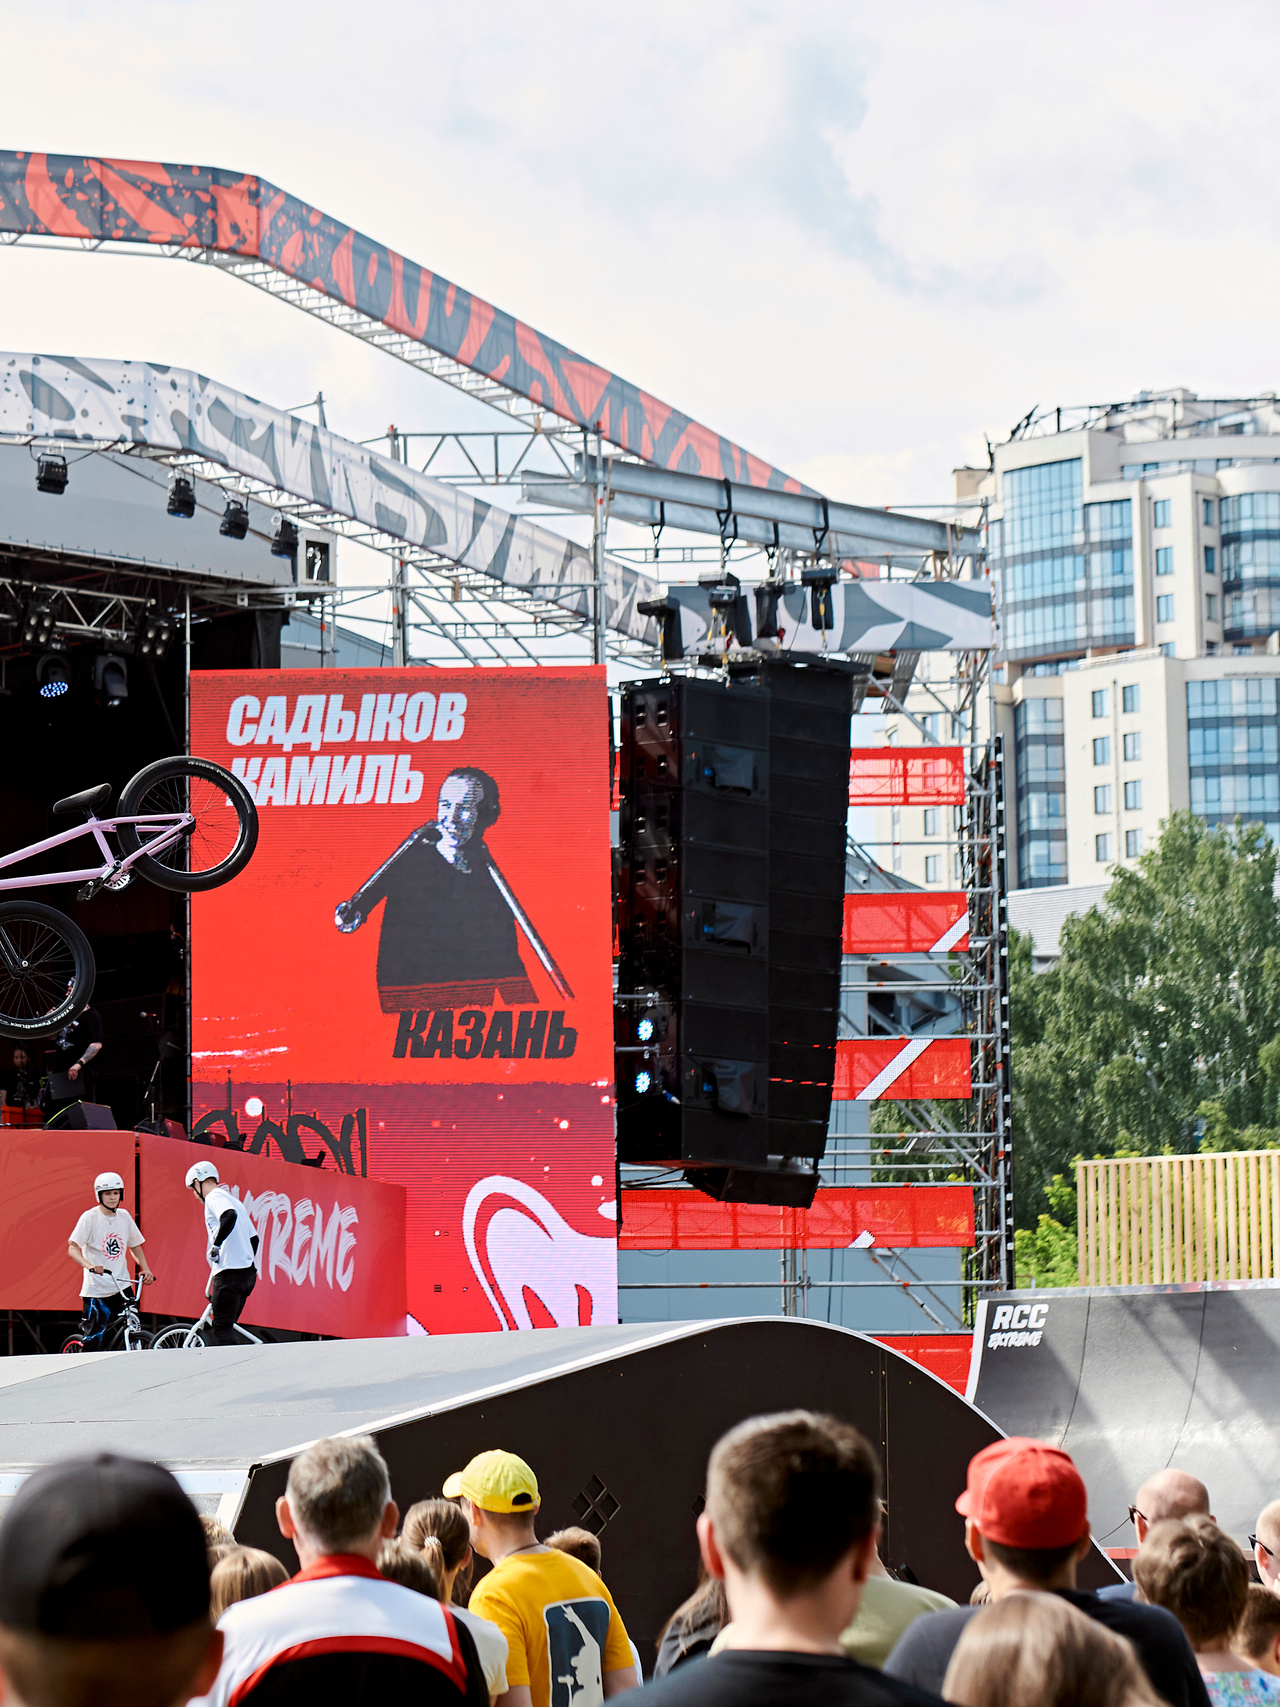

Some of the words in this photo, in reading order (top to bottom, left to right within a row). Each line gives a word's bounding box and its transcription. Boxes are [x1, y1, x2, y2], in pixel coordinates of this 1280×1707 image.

[225, 691, 468, 752] САДЫКОВ
[392, 1008, 579, 1060] КАЗАНЬ
[217, 1182, 360, 1293] TREME
[987, 1330, 1044, 1351] EXTREME
[991, 1303, 1050, 1330] RCC
